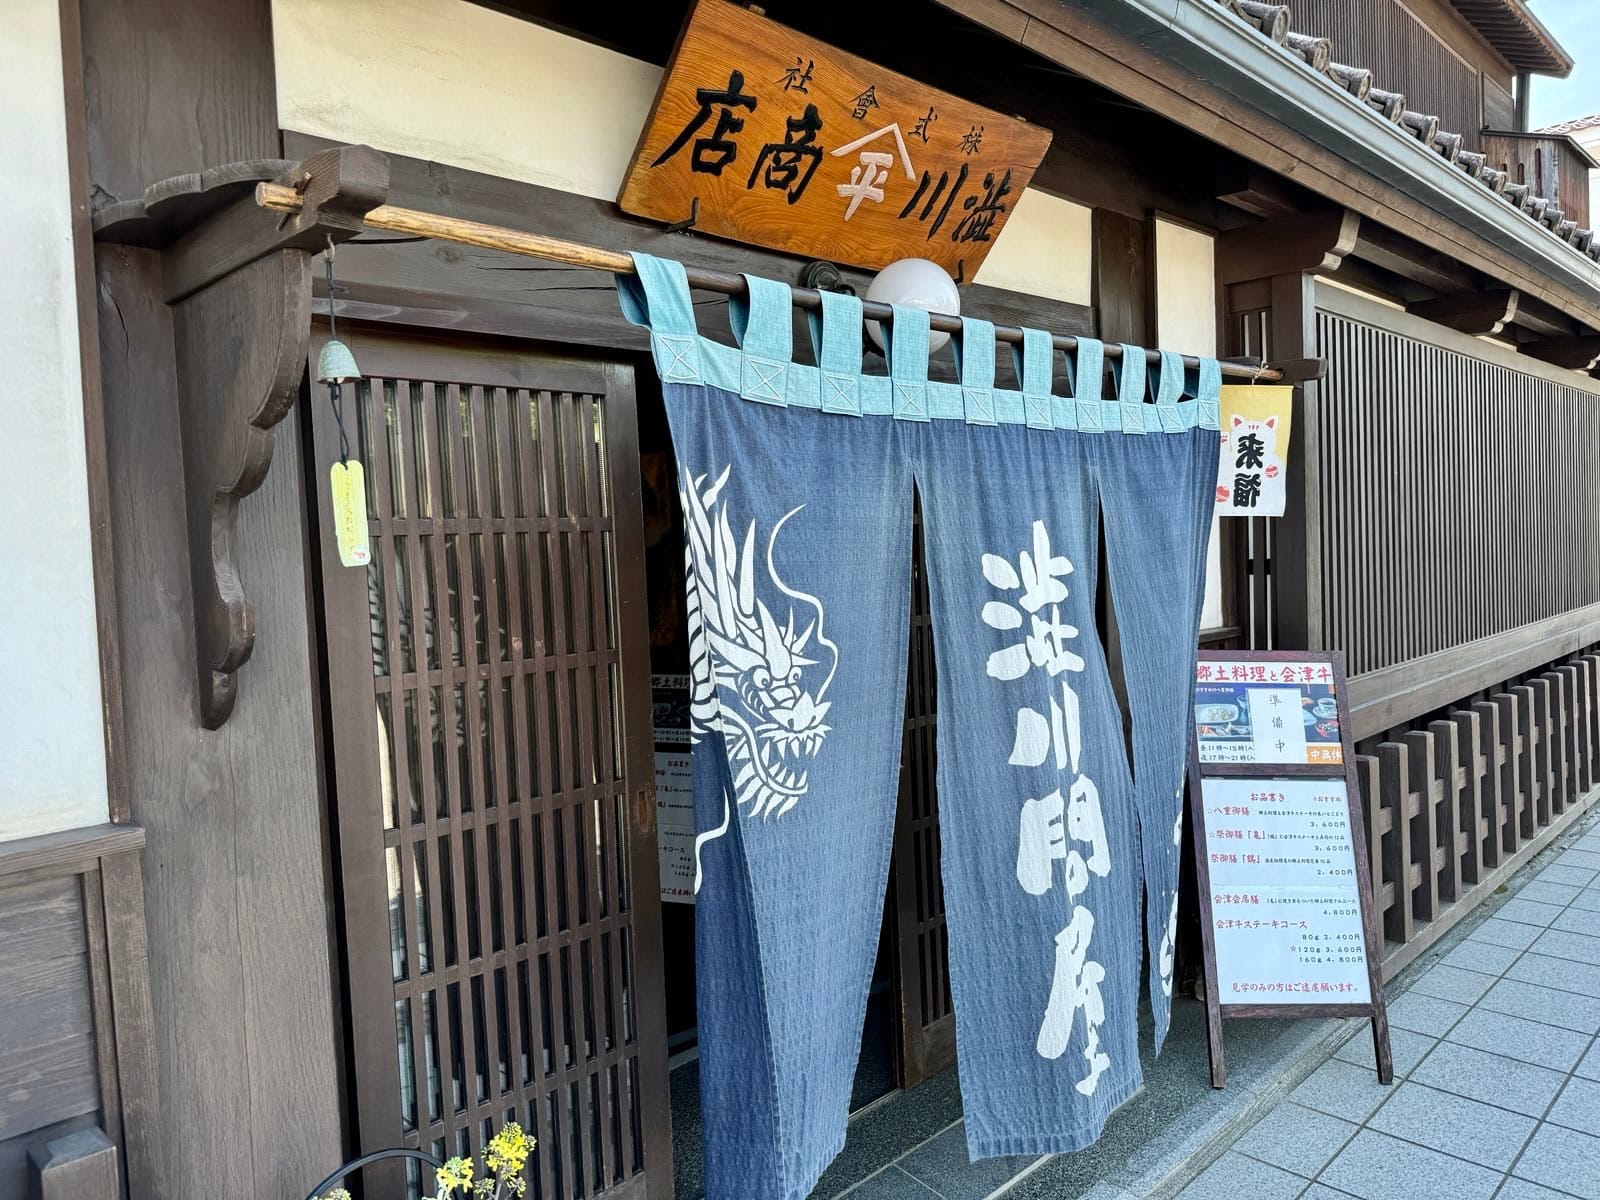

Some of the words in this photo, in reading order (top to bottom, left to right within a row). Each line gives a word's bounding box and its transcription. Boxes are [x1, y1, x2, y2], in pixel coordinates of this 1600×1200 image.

[1268, 693, 1286, 753] 準備中
[1307, 748, 1342, 761] 中無休
[1250, 792, 1285, 802] お品書き
[1215, 919, 1308, 929] 会津牛ステーキコース
